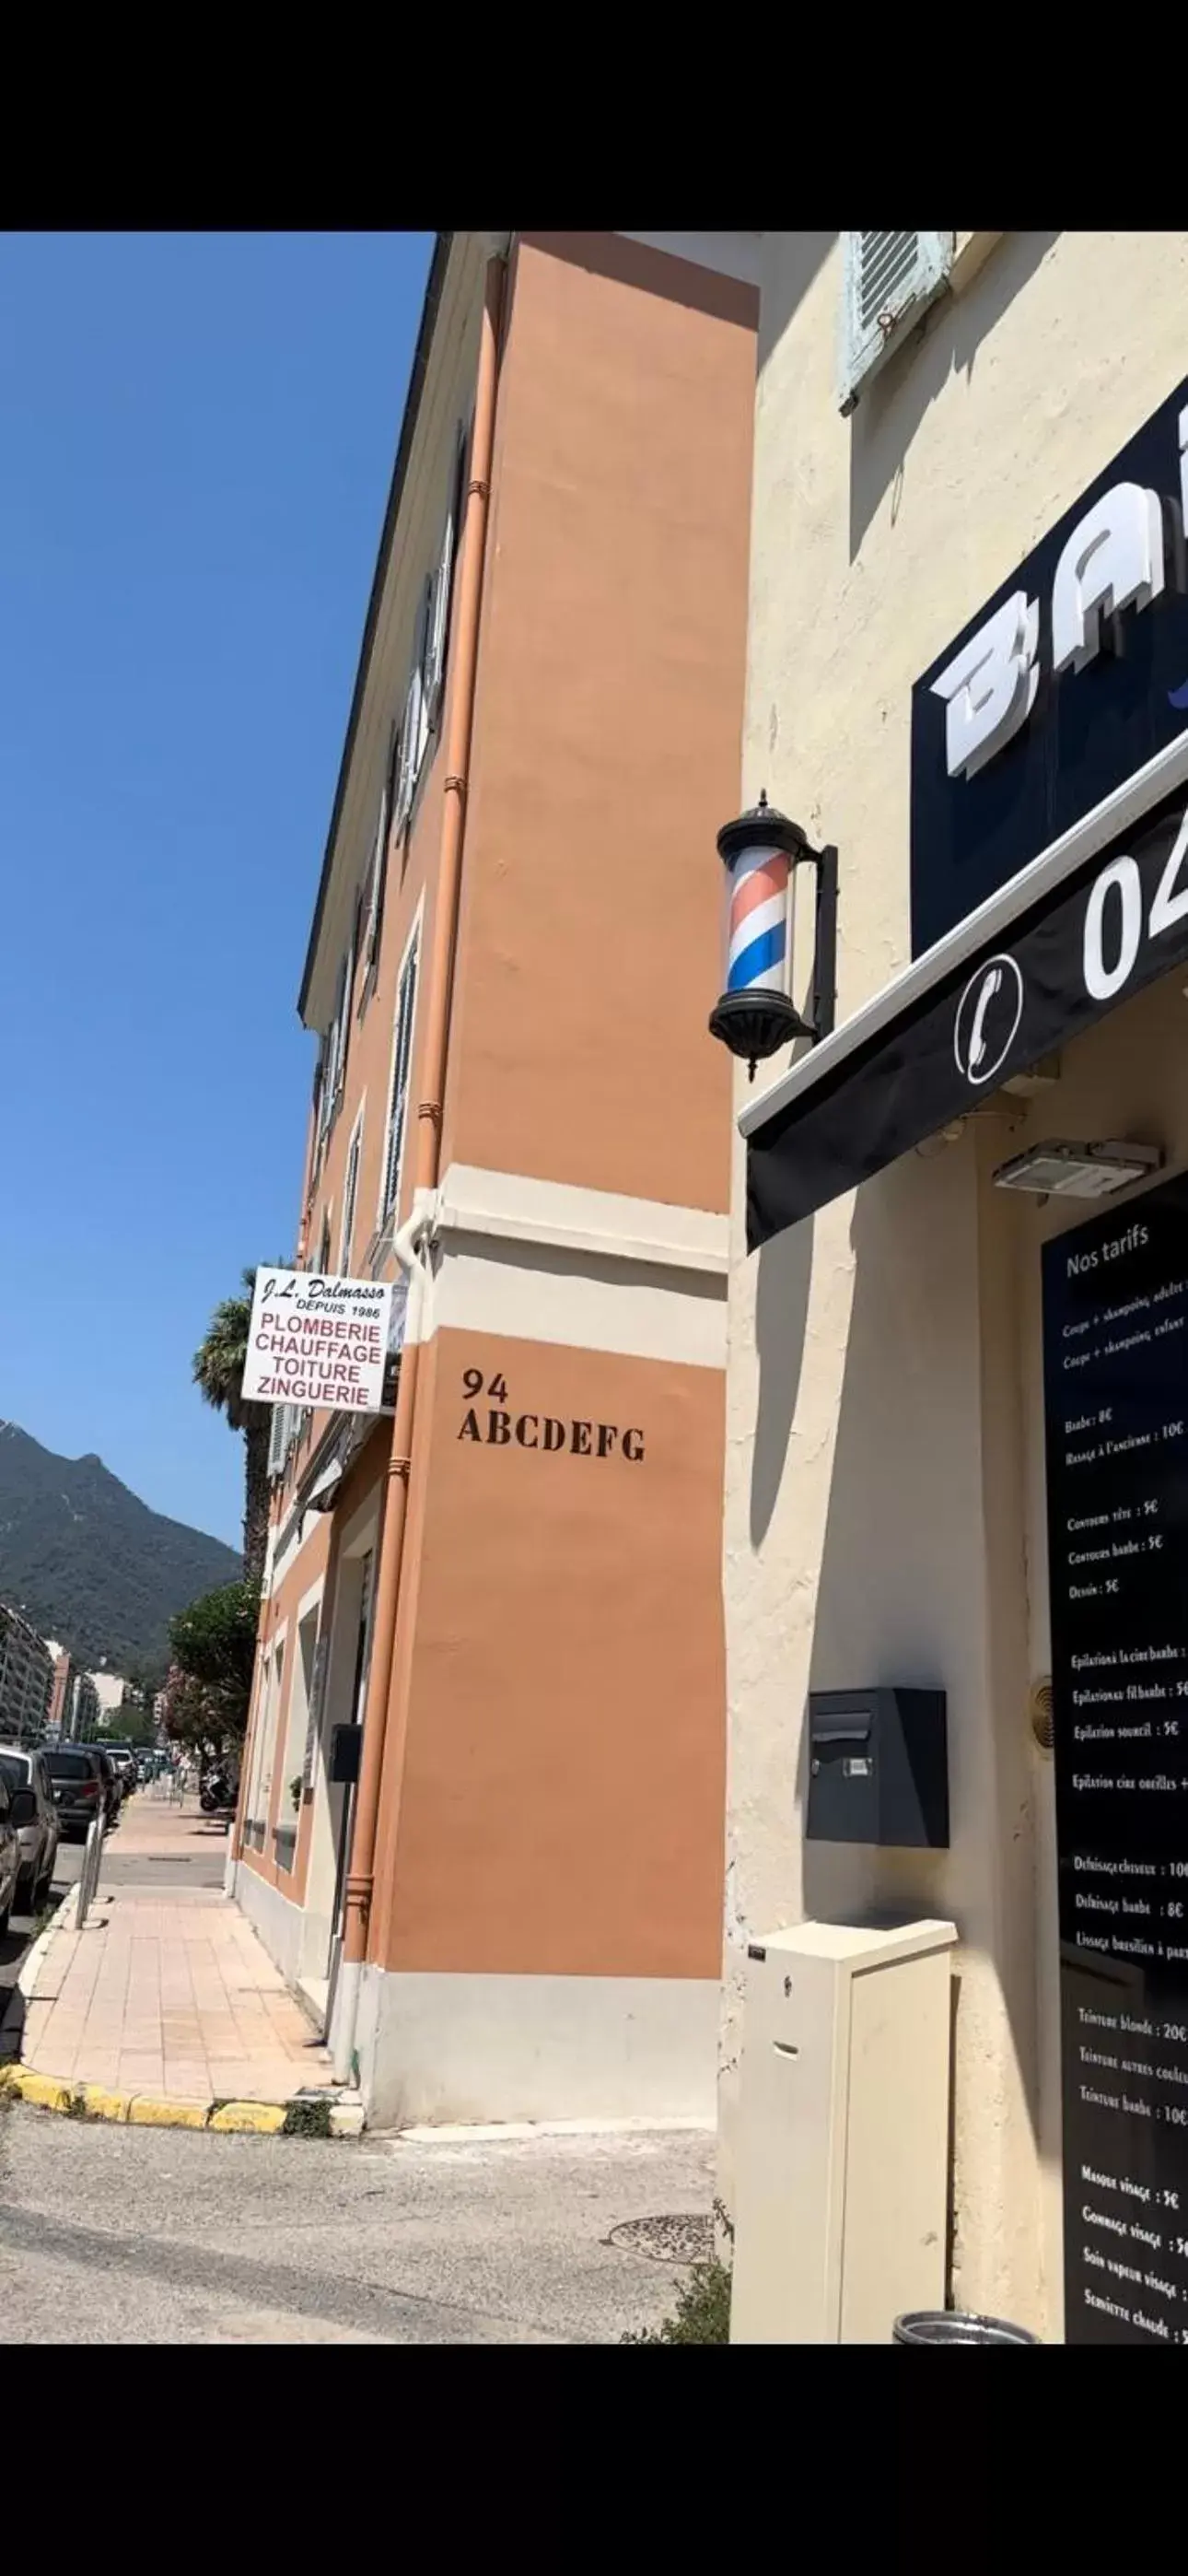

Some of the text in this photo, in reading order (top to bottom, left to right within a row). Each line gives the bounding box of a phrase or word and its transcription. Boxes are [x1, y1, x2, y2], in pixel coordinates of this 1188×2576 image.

[929, 404, 1188, 781] BA
[1066, 1224, 1149, 1279] Nos tarifs
[261, 1279, 385, 1304] J.L. Dalmasso
[297, 1299, 380, 1319] DEPUIS 1986
[261, 1312, 381, 1343] PLOMBERIE
[1155, 1317, 1184, 1336] enfant
[255, 1333, 382, 1364] CHAUFFAGE
[273, 1356, 362, 1383] TOITURE
[257, 1376, 369, 1406] ZINGUERIE
[461, 1367, 509, 1404] 94
[1099, 1407, 1112, 1423] 8€
[1162, 1421, 1184, 1439] 10€
[457, 1407, 646, 1463] ABCDEFG
[1144, 1498, 1159, 1516] 5€
[1148, 1534, 1163, 1550] 5€
[1105, 1578, 1119, 1594] 5€
[1118, 1722, 1151, 1738] sourcil
[1164, 1721, 1179, 1736] 5€
[1139, 1774, 1177, 1790] oreilles
[1123, 1896, 1150, 1914] barbe
[1167, 1902, 1184, 1917] 8€
[1076, 1930, 1109, 1951] Lissage
[1077, 2008, 1117, 2029] Teinture
[1121, 2013, 1152, 2034] blonde
[1163, 2023, 1187, 2042] 20€
[1079, 2045, 1118, 2068] Teinture
[1122, 2060, 1153, 2075] autres
[1079, 2085, 1120, 2109] Teinture
[1123, 2094, 1151, 2117] barbe
[1165, 2105, 1188, 2126] 10€
[1081, 2165, 1117, 2189] Masque
[1119, 2177, 1150, 2202] visage
[1163, 2190, 1180, 2209] 5€
[1082, 2206, 1127, 2236] Gommage
[1130, 2223, 1161, 2250] visage
[1083, 2246, 1105, 2267] Soin
[1107, 2259, 1142, 2283] vapeur
[1145, 2271, 1177, 2300] visage
[1084, 2288, 1130, 2322] Serviette
[1133, 2310, 1169, 2338] chaude
